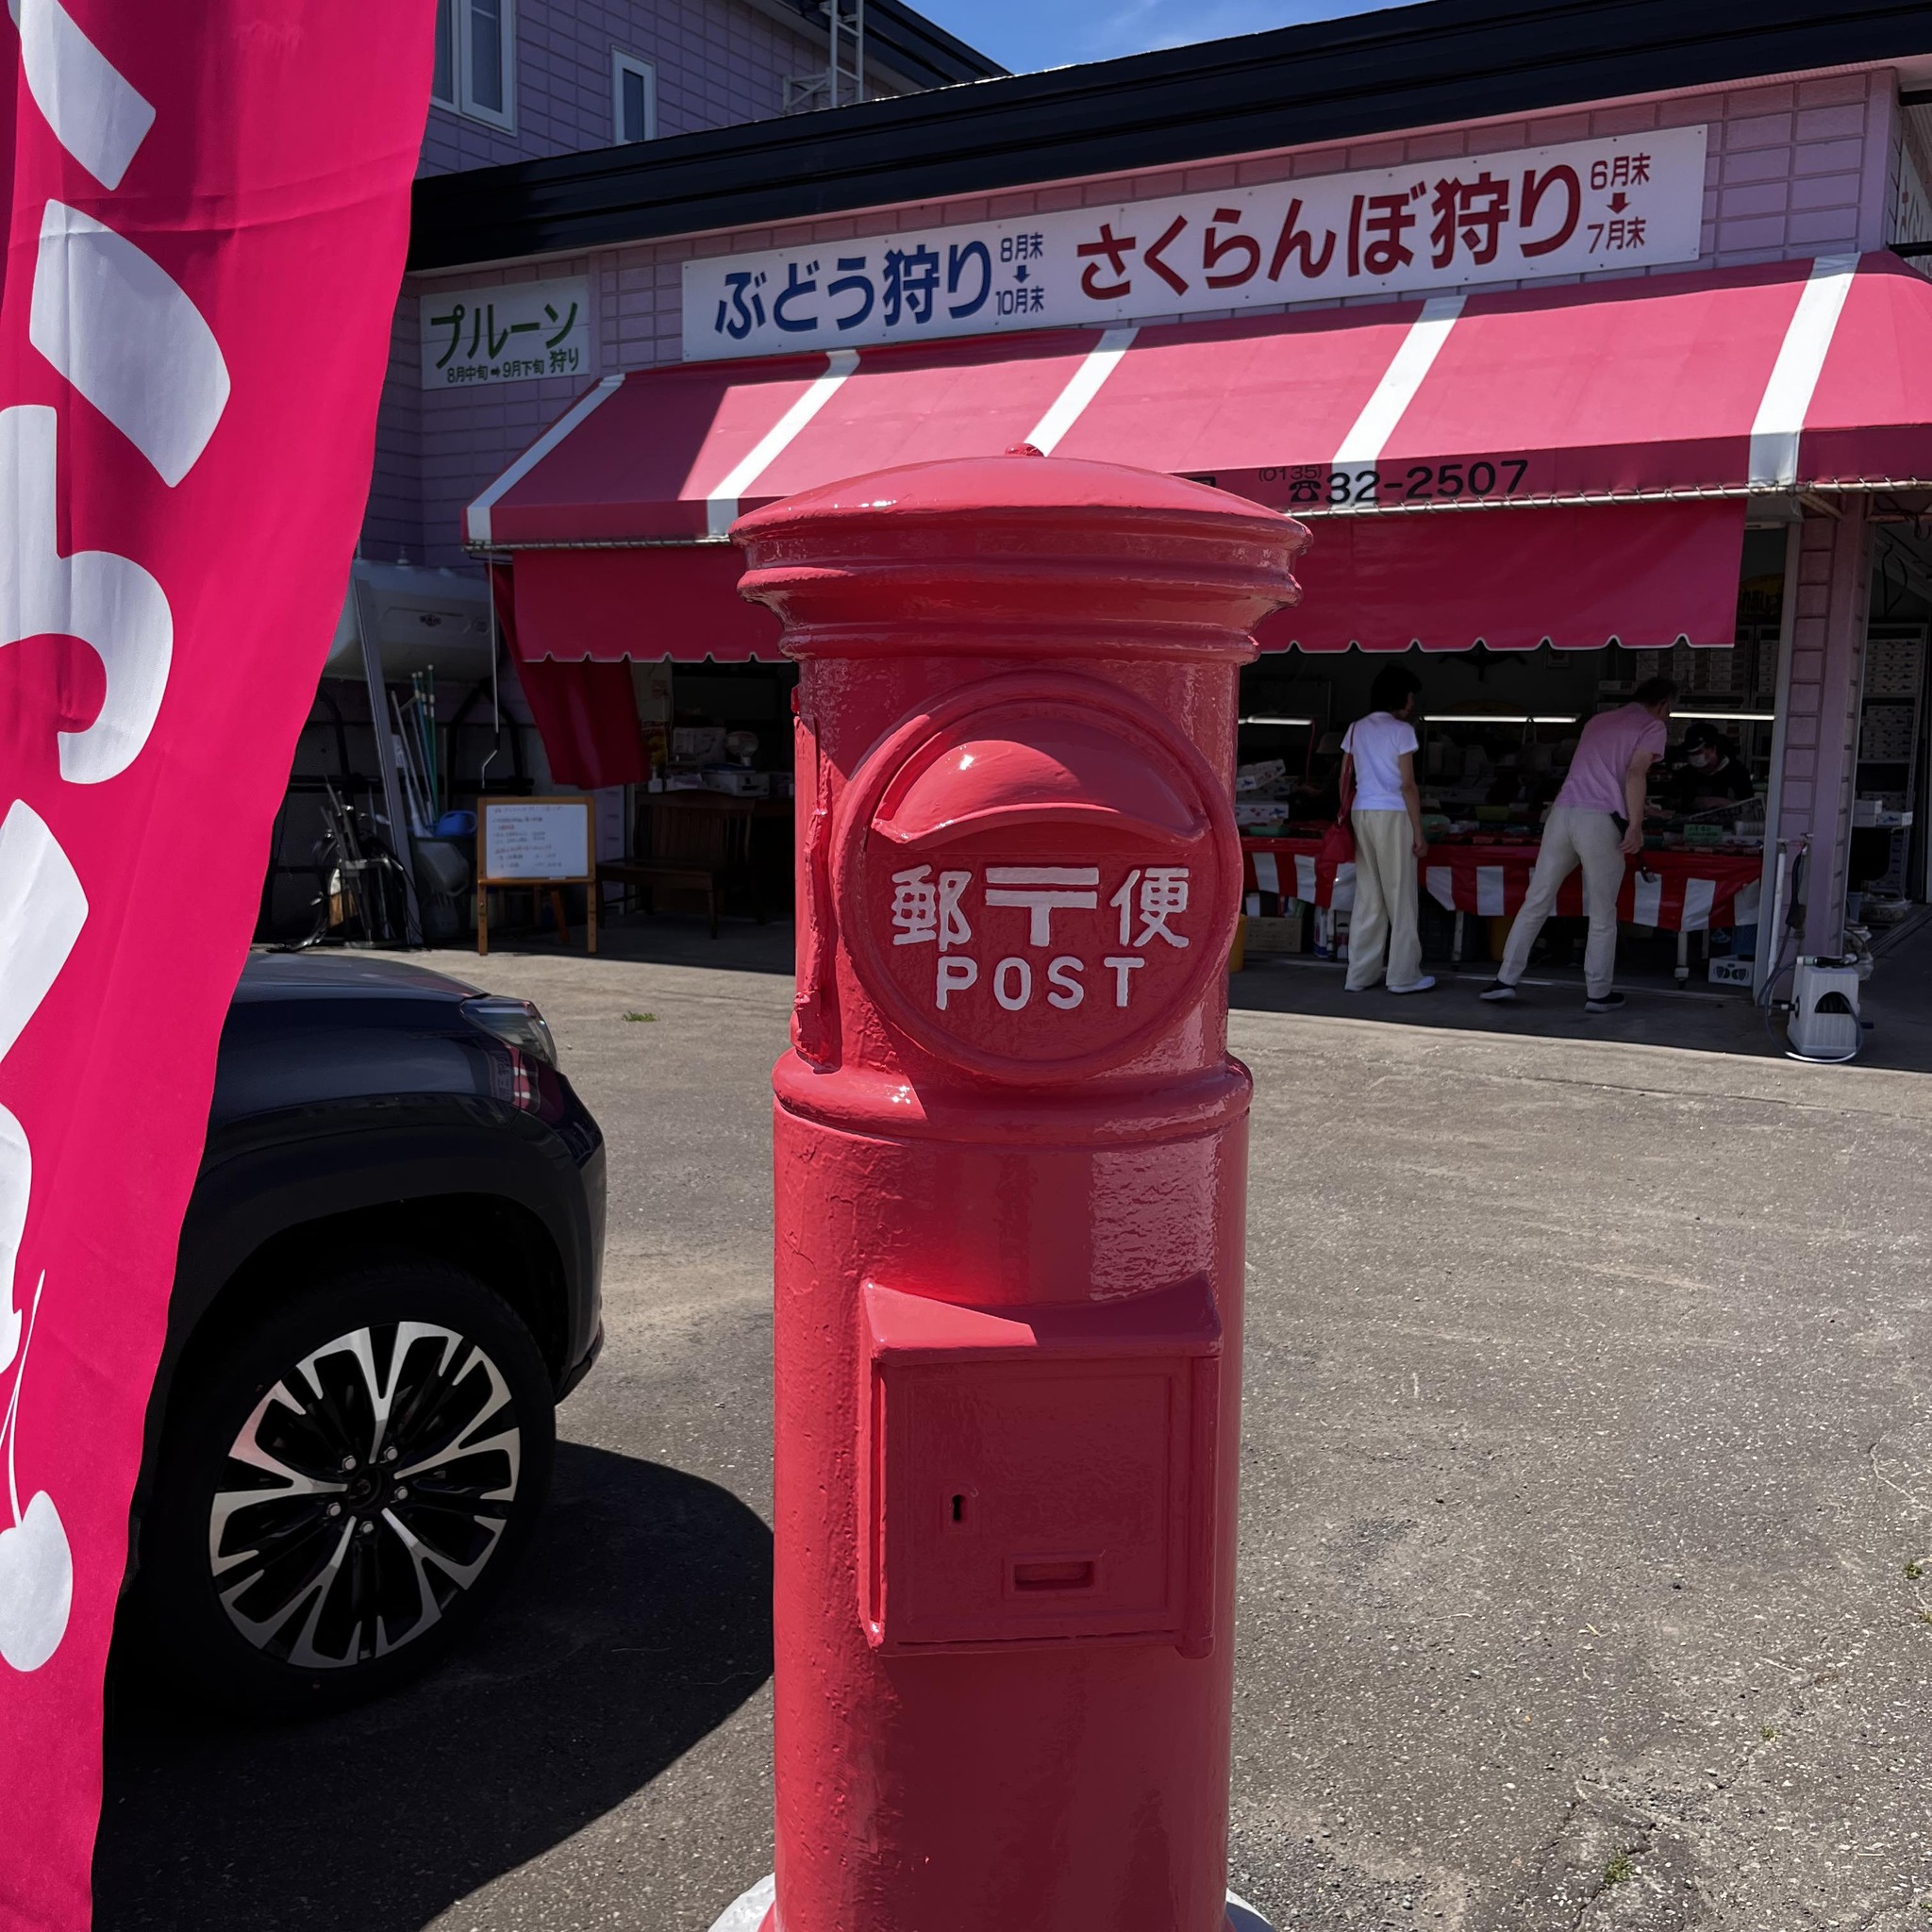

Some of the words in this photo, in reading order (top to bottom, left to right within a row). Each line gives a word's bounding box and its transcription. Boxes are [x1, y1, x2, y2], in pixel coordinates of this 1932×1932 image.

[1591, 152, 1651, 191] 6月末
[1000, 232, 1043, 262] 8月末
[1076, 163, 1581, 300] さくらんぼ狩り
[1587, 216, 1646, 254] 7月末
[715, 241, 991, 340] ぶどう狩り
[995, 286, 1044, 316] 10月末
[430, 301, 578, 370] プルーン
[447, 365, 489, 383] 8月中旬
[502, 358, 544, 378] 9月下旬
[549, 347, 579, 375] 狩り
[1325, 459, 1528, 505] 32-2507
[936, 956, 1145, 1010] POST
